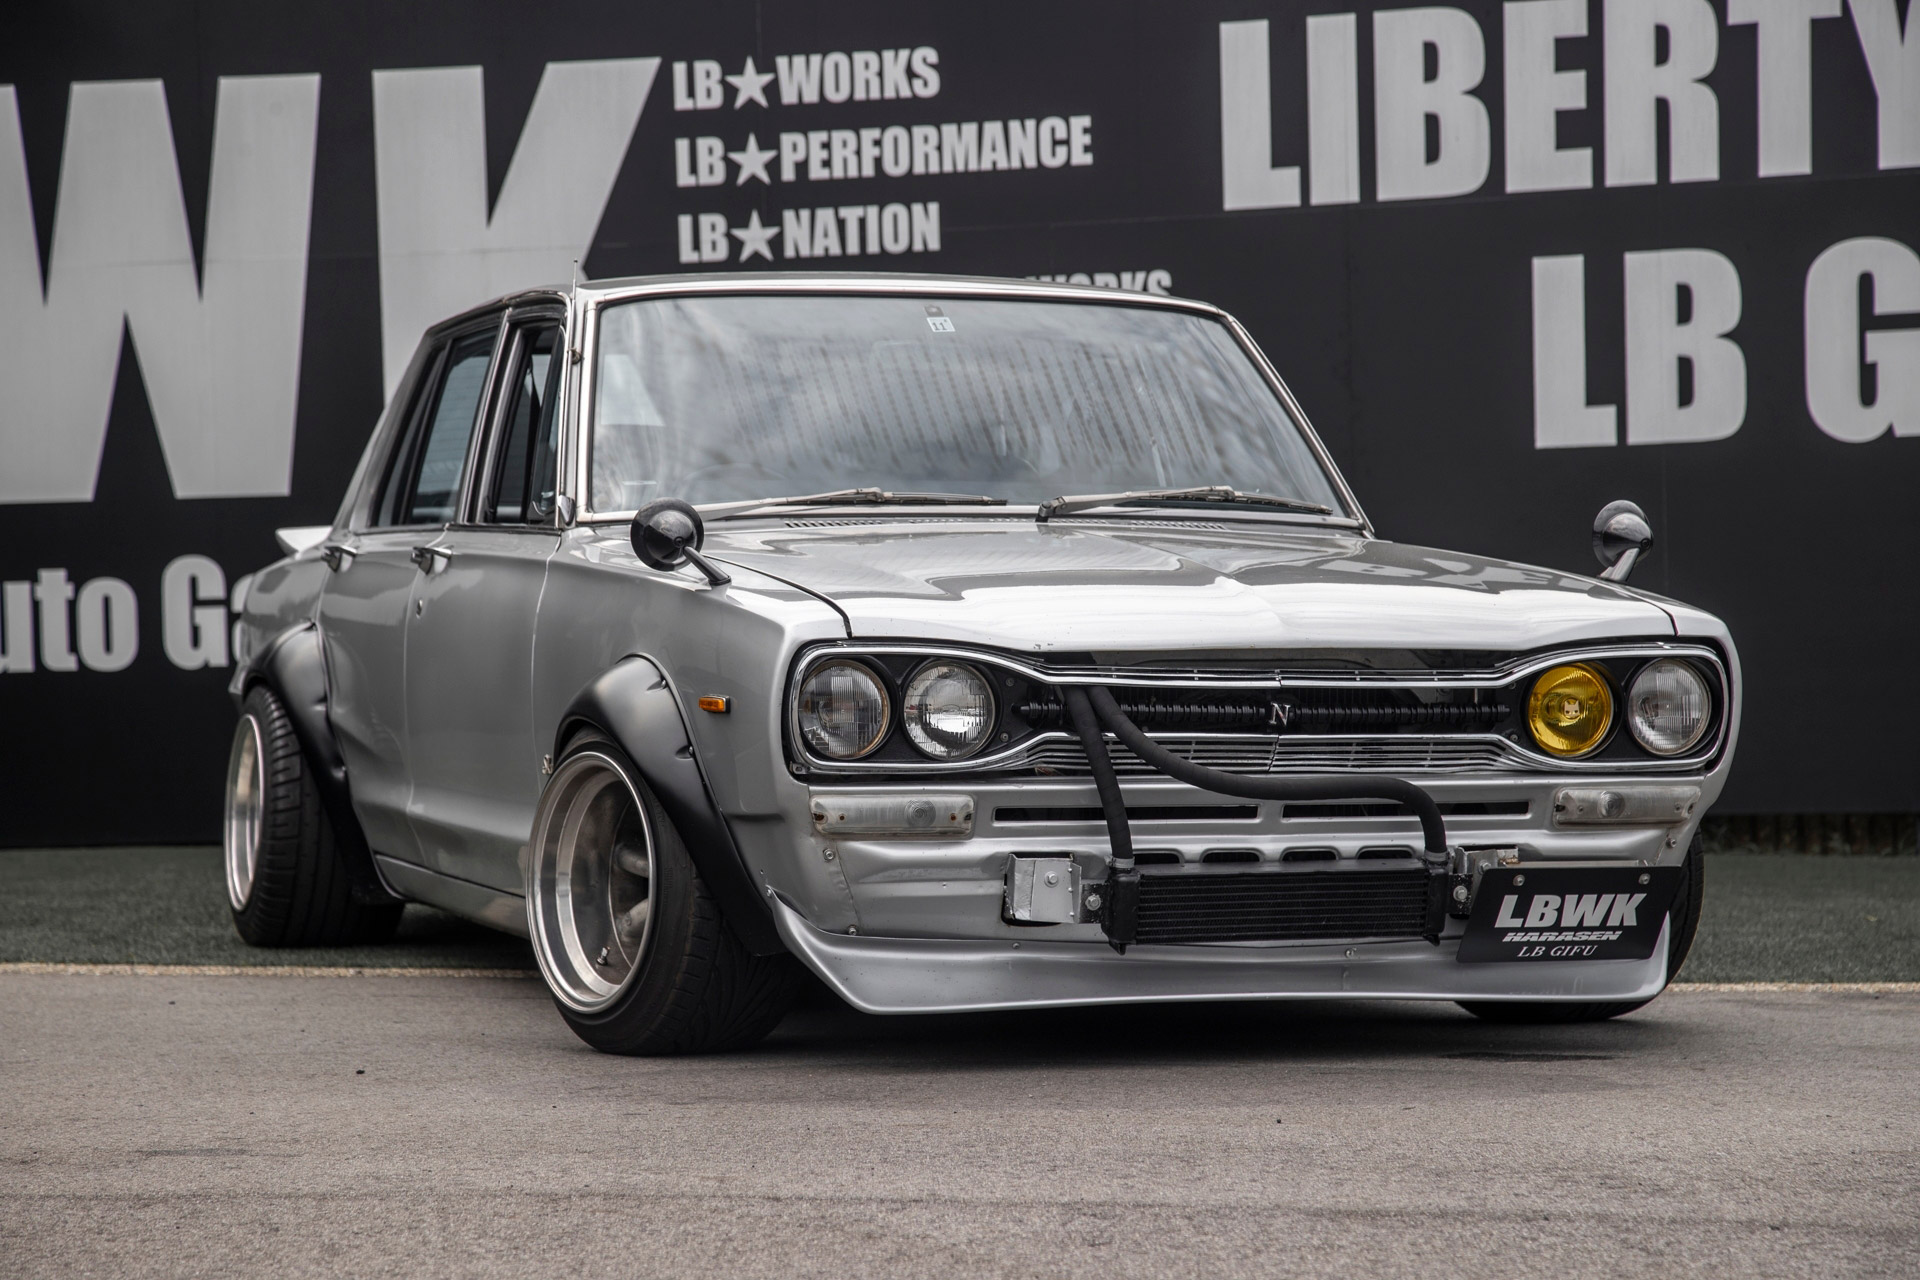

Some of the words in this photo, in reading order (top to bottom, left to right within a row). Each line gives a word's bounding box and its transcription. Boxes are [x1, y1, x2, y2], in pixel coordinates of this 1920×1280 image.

[1219, 0, 1920, 211] LIBERTY
[1531, 248, 1747, 450] LB
[1269, 702, 1291, 726] N
[1494, 893, 1647, 928] LBWK
[1502, 930, 1623, 943] HARASEN
[1517, 945, 1546, 958] LB
[1550, 944, 1598, 957] GIFU
